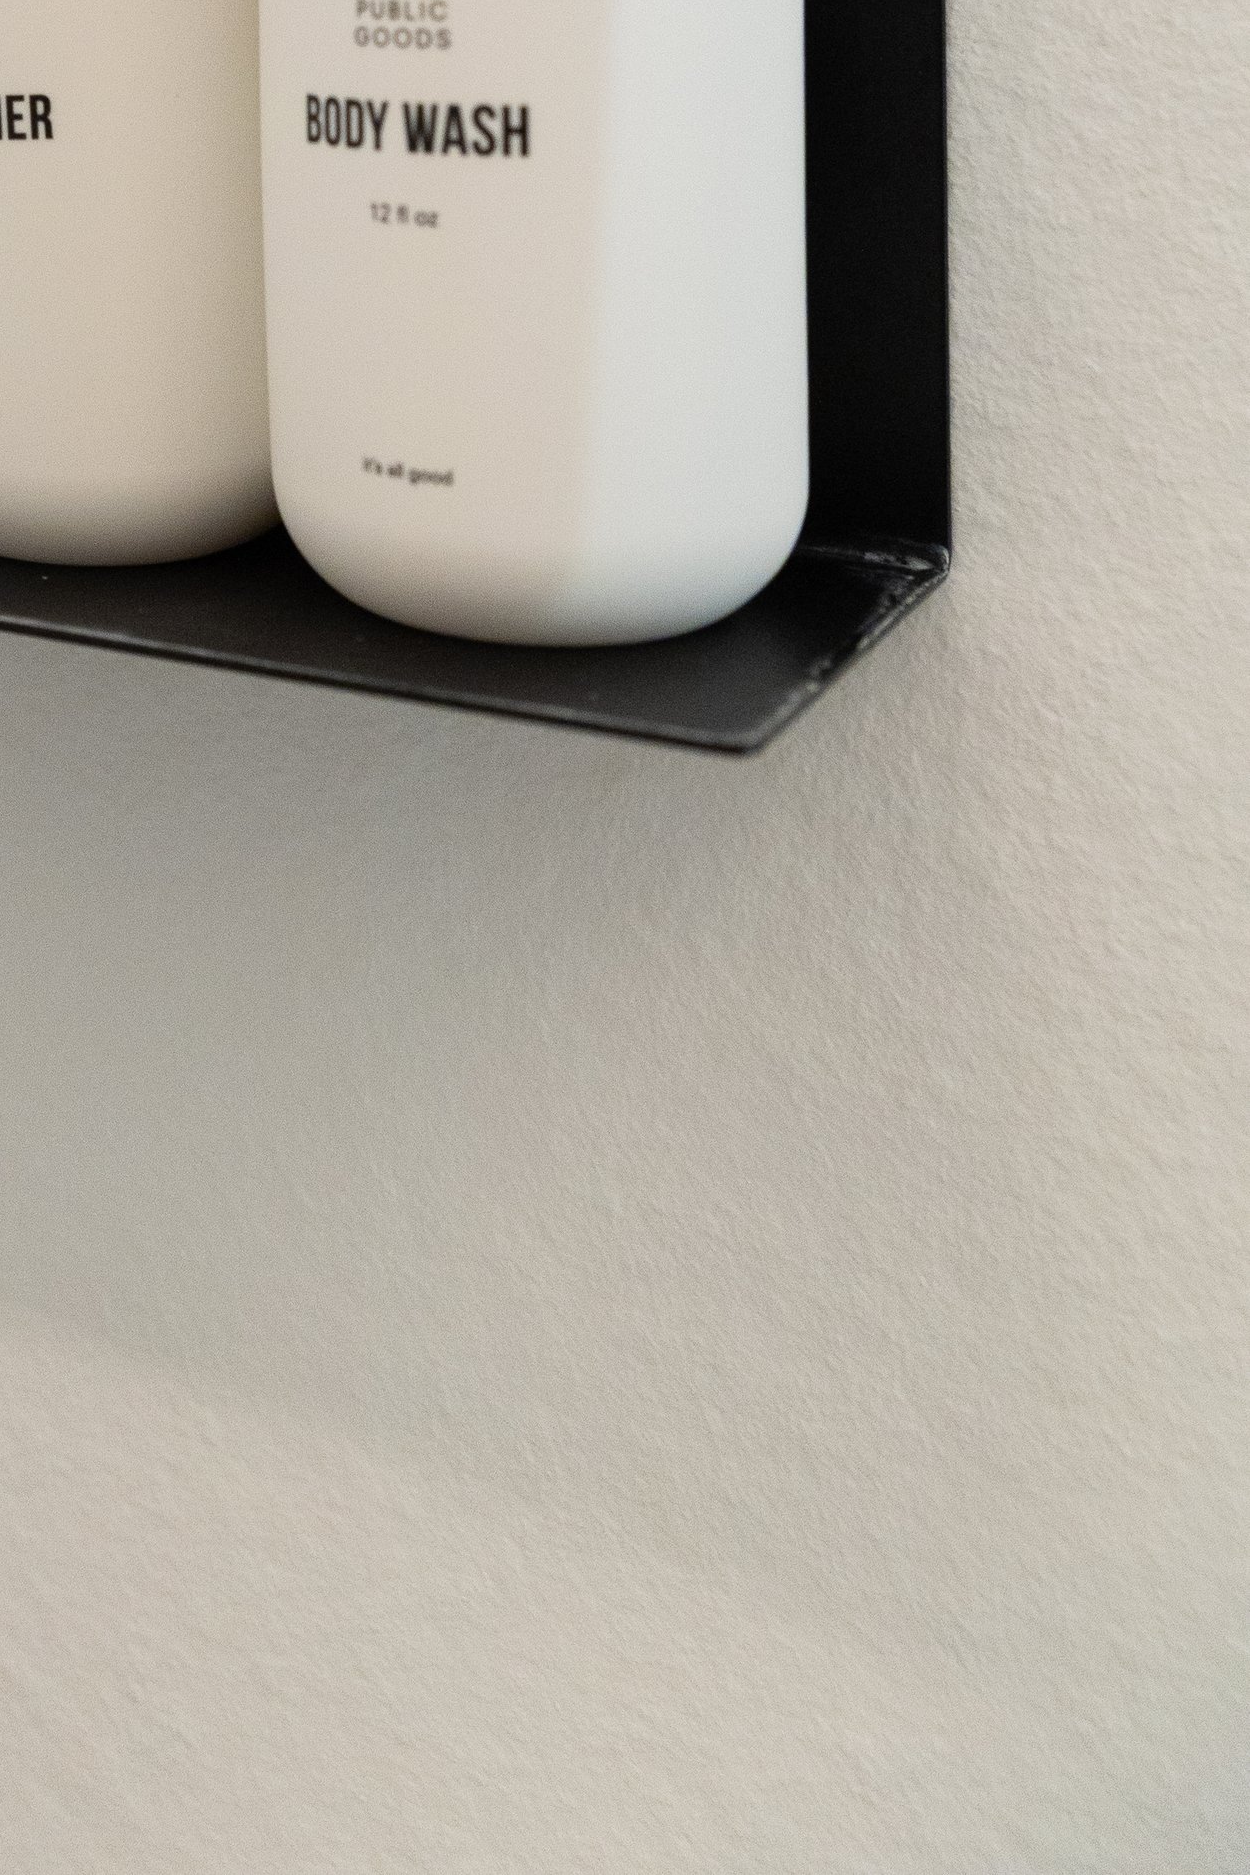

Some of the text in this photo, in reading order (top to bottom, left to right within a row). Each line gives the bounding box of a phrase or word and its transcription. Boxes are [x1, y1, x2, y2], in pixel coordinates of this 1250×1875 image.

[353, 25, 453, 51] GOODS
[305, 92, 532, 158] BODY WASH
[370, 201, 391, 225] 12
[413, 209, 440, 229] oz
